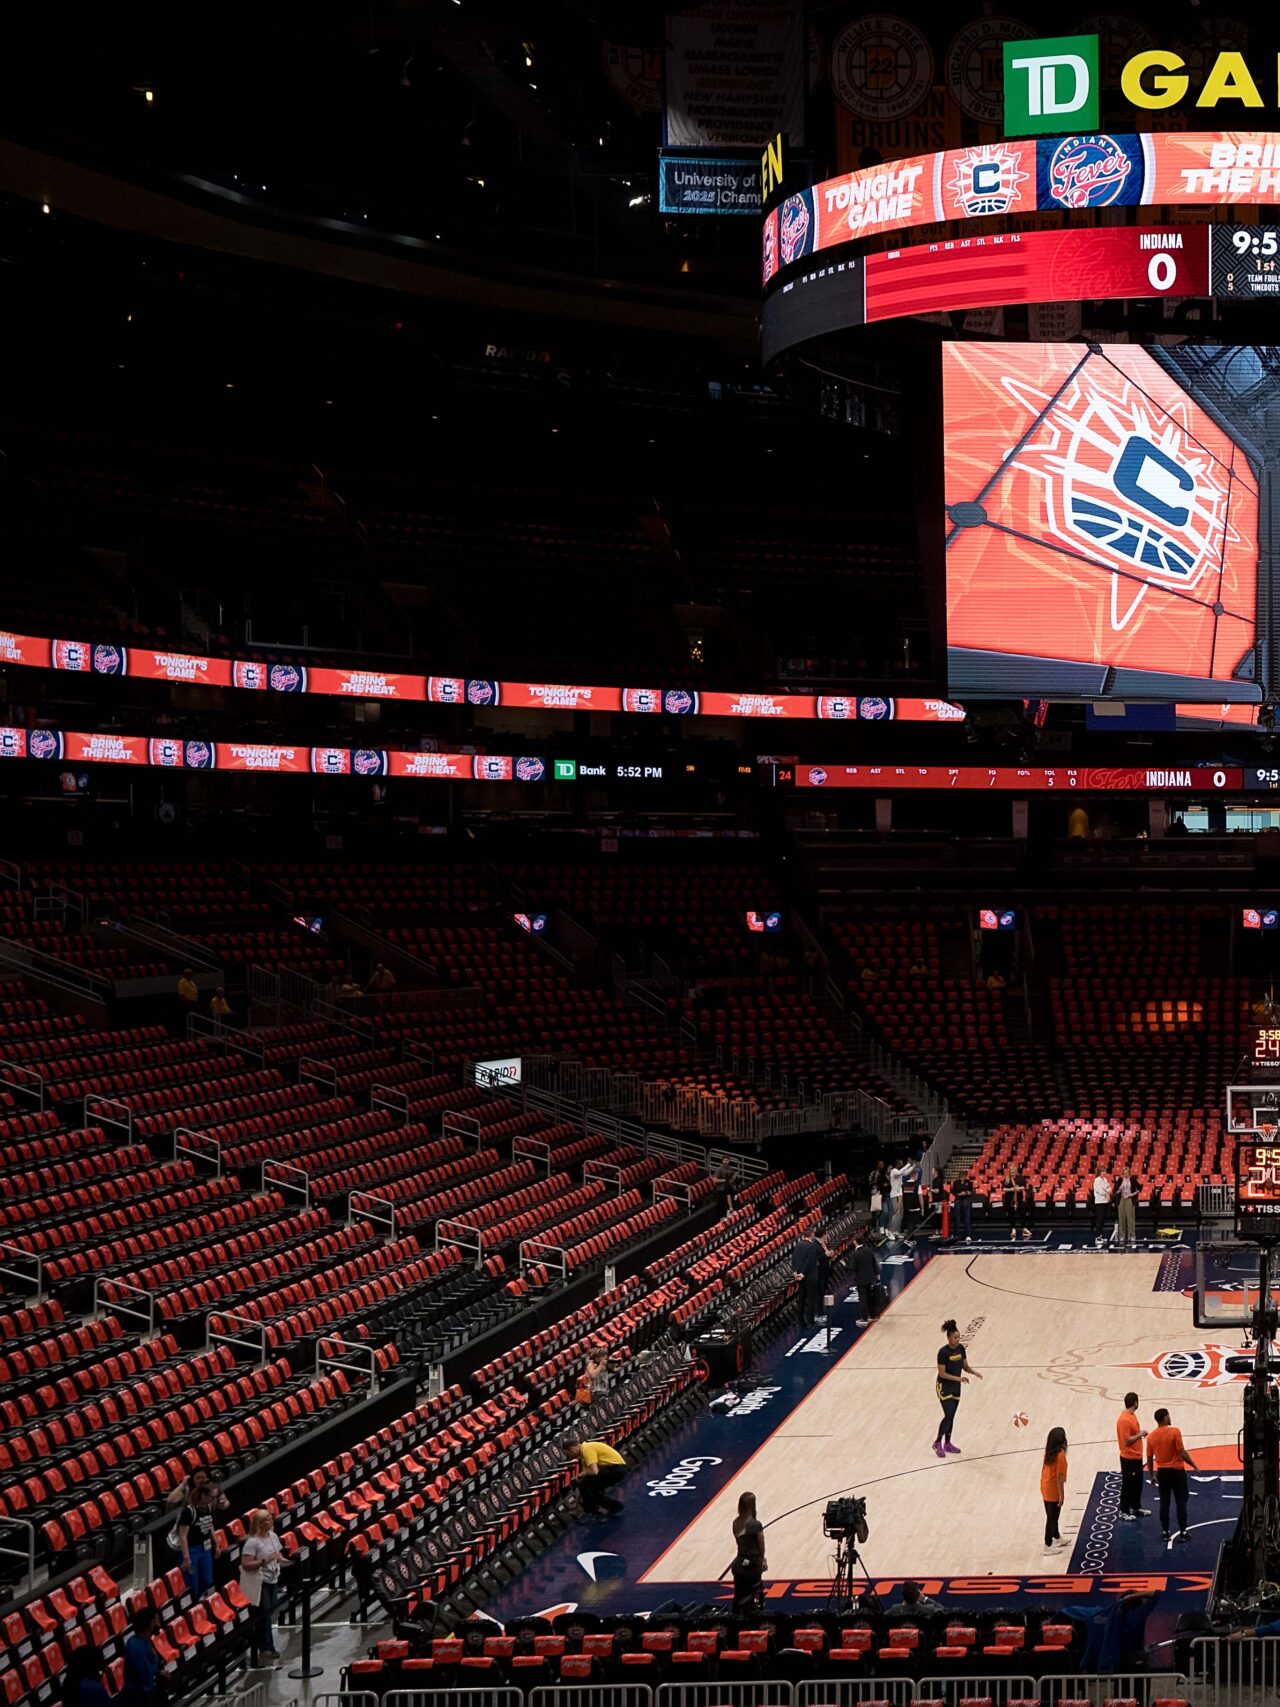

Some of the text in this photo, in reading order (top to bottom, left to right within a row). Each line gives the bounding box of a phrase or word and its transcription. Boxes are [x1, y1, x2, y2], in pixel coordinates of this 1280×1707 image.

[868, 57, 894, 74] 22
[1012, 54, 1089, 116] TD
[1060, 136, 1114, 160] INDIANA
[674, 171, 756, 189] University of
[1051, 151, 1131, 198] Fever
[1180, 169, 1252, 194] THE
[825, 165, 923, 212] TONIGHT
[848, 193, 914, 230] GAME
[1140, 234, 1184, 250] INDIANA
[1147, 253, 1177, 290] 0
[1255, 260, 1276, 271] 1st
[1227, 273, 1234, 282] 0
[1247, 274, 1262, 283] TEAM
[1227, 282, 1234, 291] 5
[1250, 283, 1280, 292] TIMEOUTS
[1113, 435, 1196, 527] C
[154, 654, 208, 671] TONIGHT'S
[166, 667, 196, 679] GAME
[350, 675, 386, 686] BRING
[341, 683, 396, 696] THE HEAT
[529, 687, 592, 699] TONIGHT'S
[543, 696, 578, 706] GAME
[738, 696, 774, 707] BRING
[730, 704, 752, 714] THE
[90, 737, 123, 749] BRING
[82, 747, 133, 760] THE HEAT
[231, 747, 294, 760] TONIGHT'S
[245, 757, 280, 768] GAME
[413, 756, 448, 767] BRING
[405, 764, 457, 775] THE HEAT
[556, 762, 606, 776] TD Bank
[617, 766, 663, 778] 5:52 PM
[779, 770, 791, 780] 24
[1047, 777, 1077, 787] 5 0
[1145, 771, 1226, 787] INDIANA 0
[1259, 1029, 1280, 1040] 9:58
[1255, 1040, 1279, 1058] 24
[646, 1456, 723, 1497] Google
